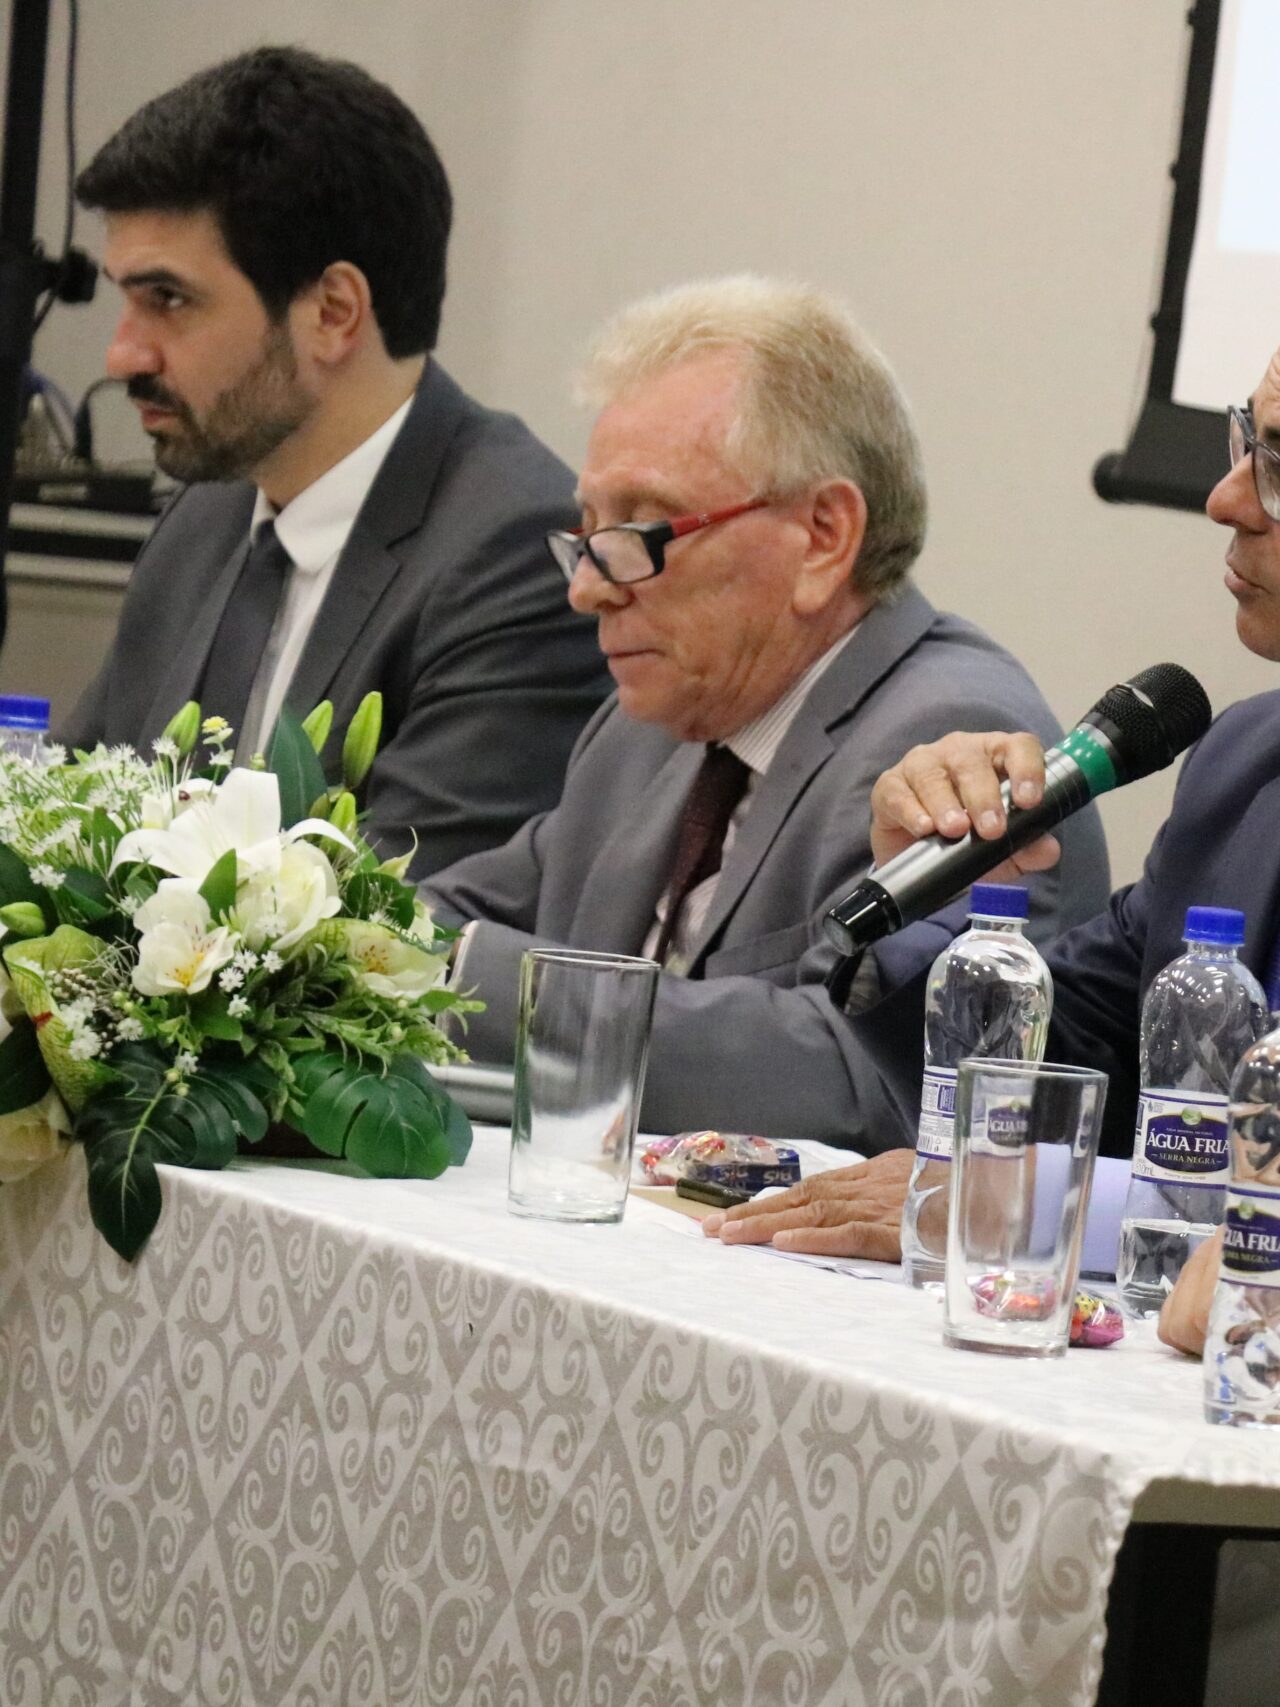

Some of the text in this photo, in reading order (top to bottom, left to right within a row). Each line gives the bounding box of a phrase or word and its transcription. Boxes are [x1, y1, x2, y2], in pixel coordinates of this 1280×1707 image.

[1146, 1127, 1191, 1152] ÁGUA
[1160, 1152, 1185, 1163] SERRA
[1186, 1155, 1216, 1166] NEGRA
